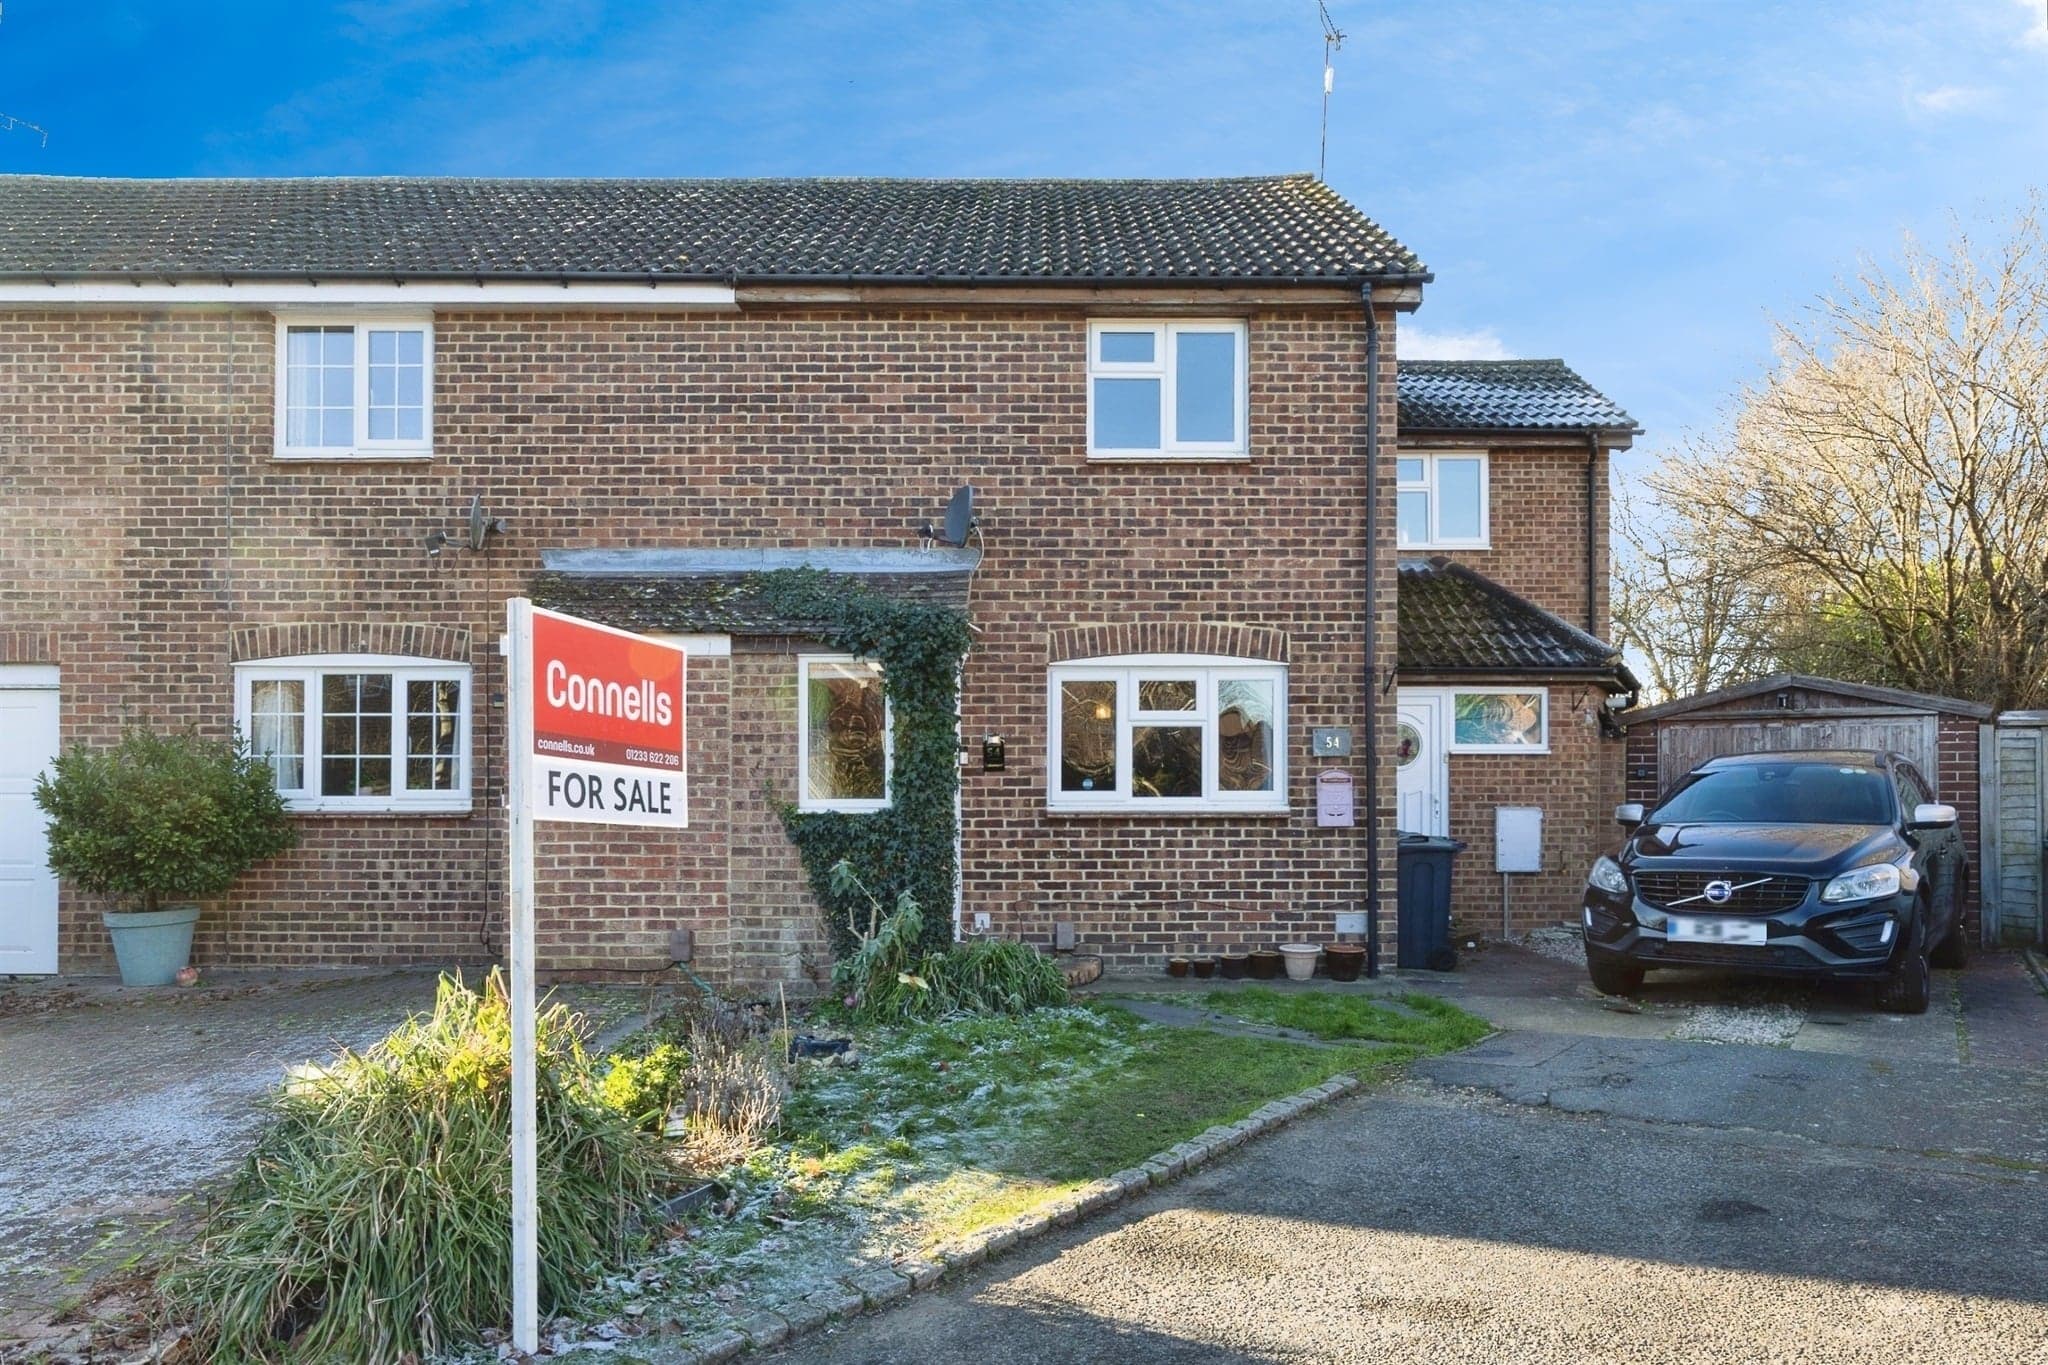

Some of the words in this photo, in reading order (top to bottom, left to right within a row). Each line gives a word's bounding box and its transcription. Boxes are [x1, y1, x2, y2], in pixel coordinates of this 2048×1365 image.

[547, 660, 672, 726] Connells
[538, 739, 595, 756] connells.co.uk
[1326, 736, 1340, 749] 54
[626, 748, 648, 762] 01233
[649, 751, 663, 764] 622
[548, 770, 605, 810] FOR
[613, 777, 672, 814] SALE
